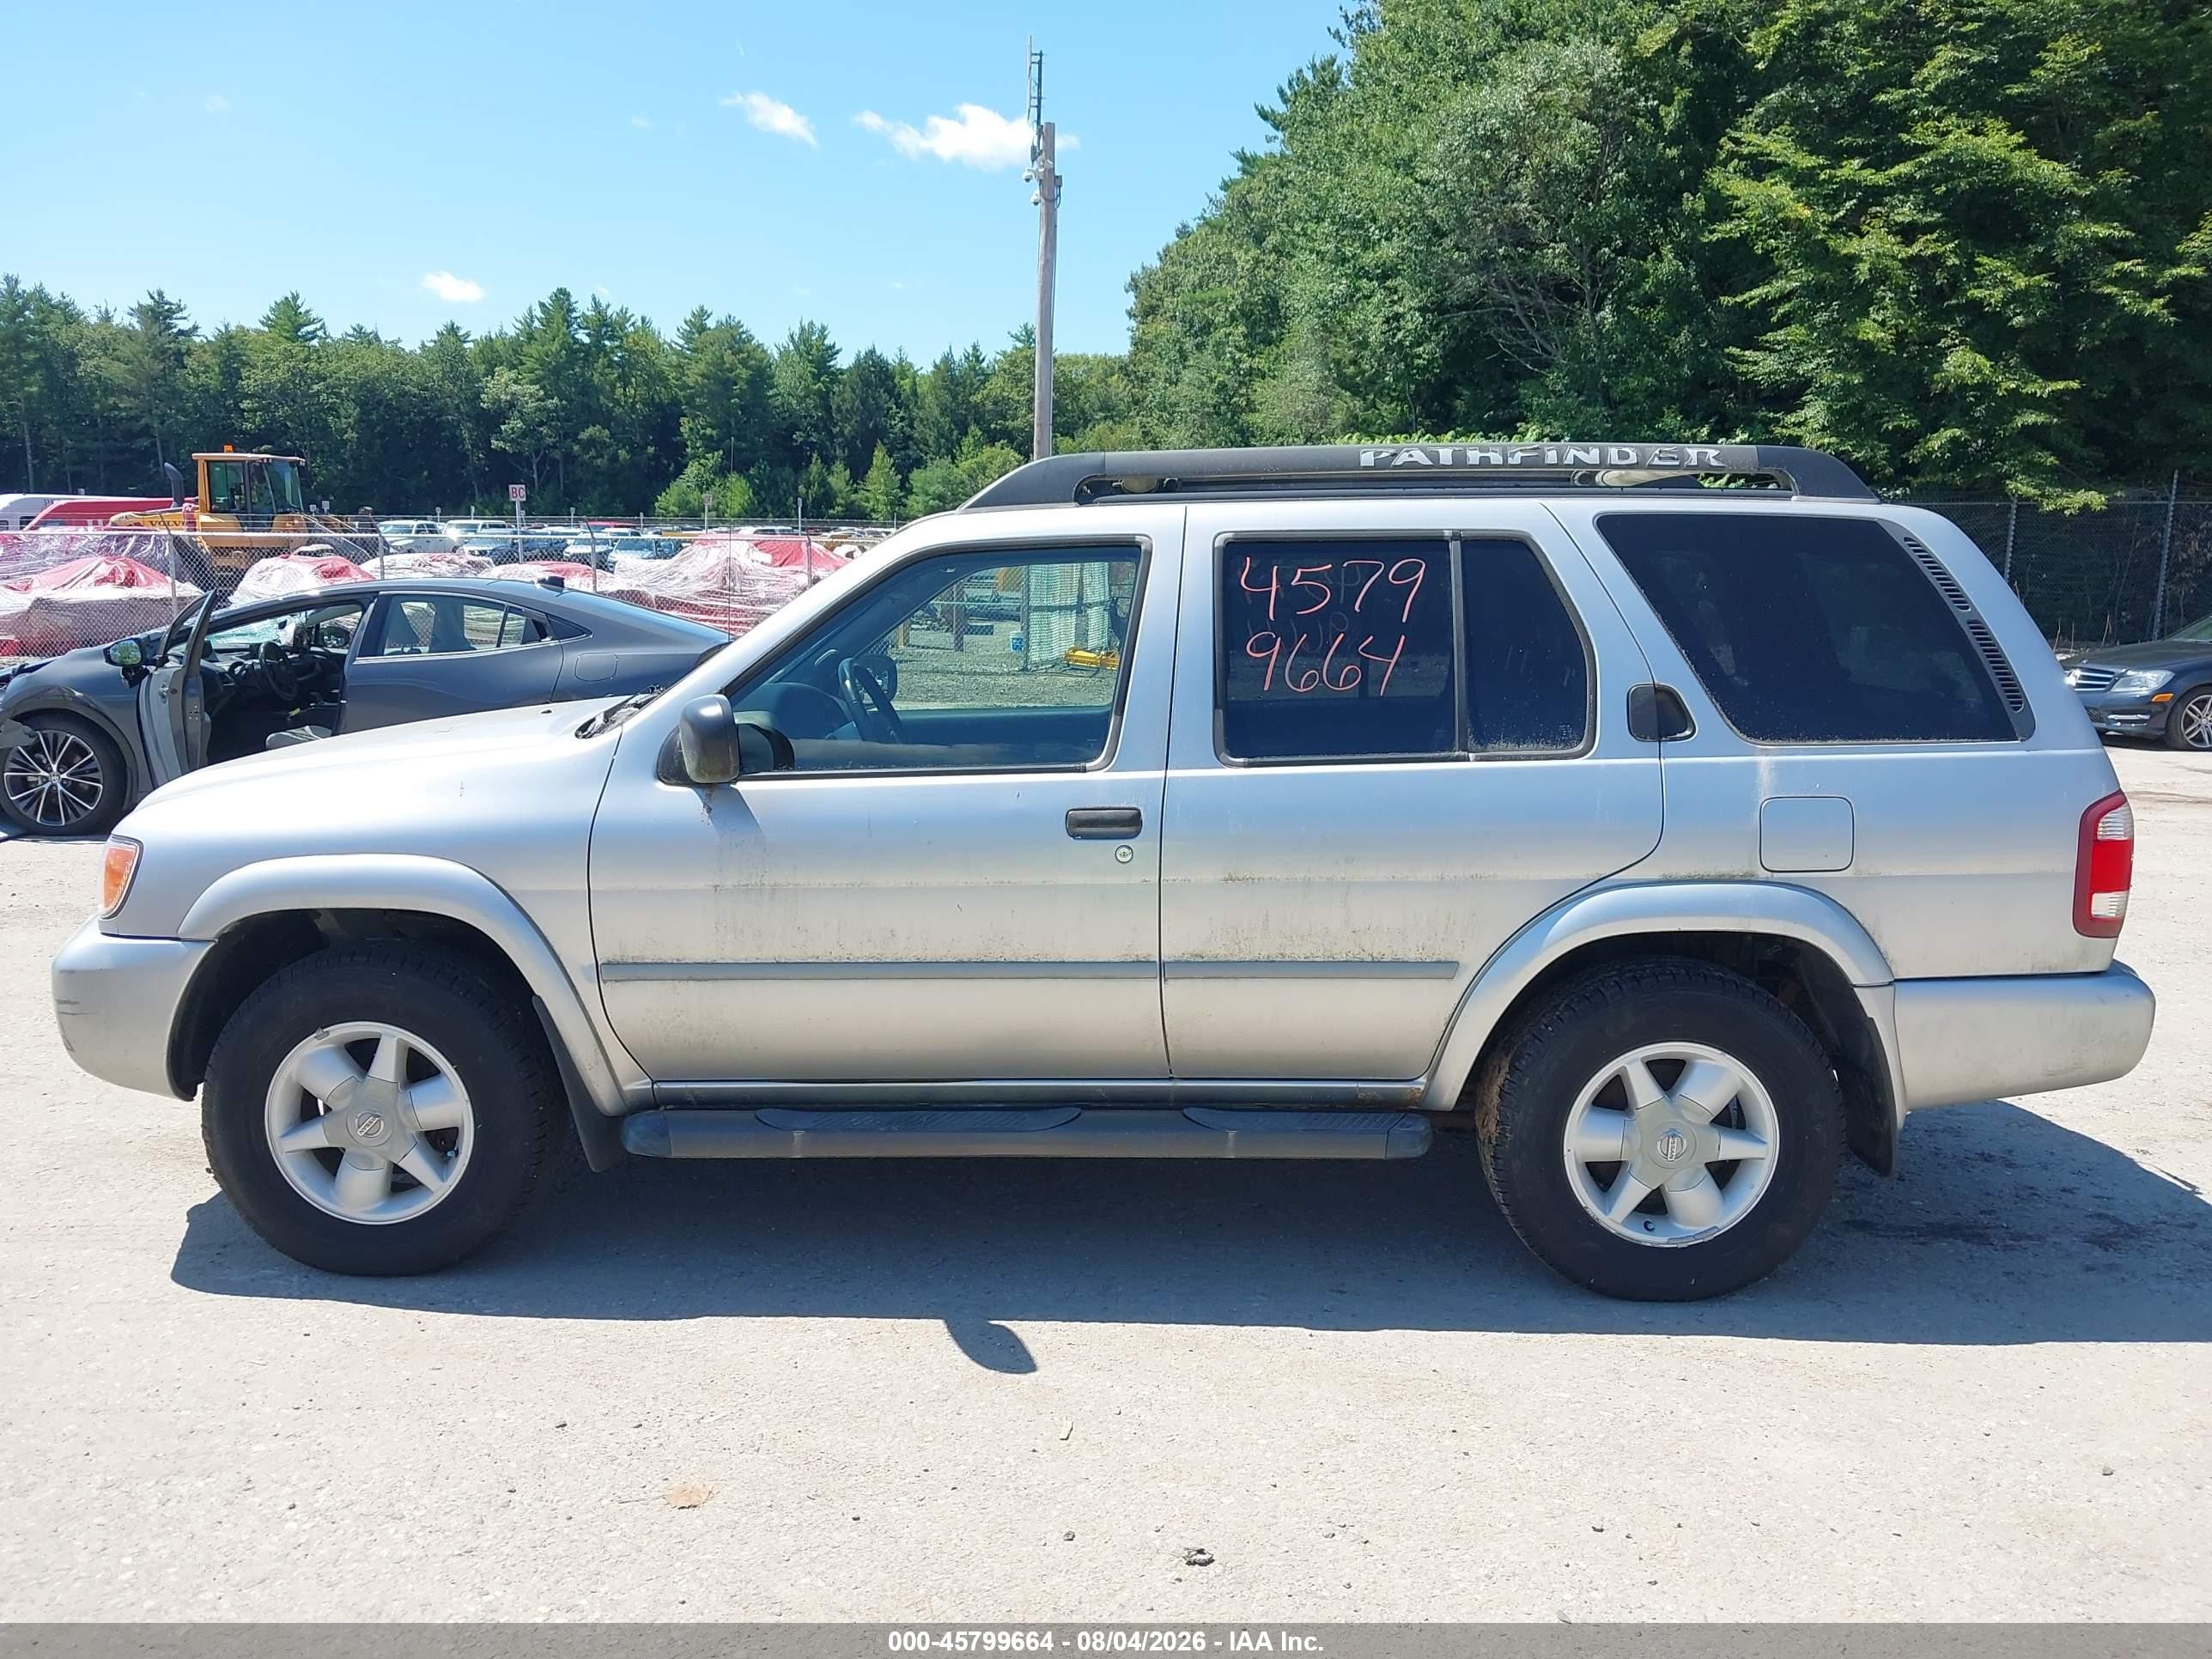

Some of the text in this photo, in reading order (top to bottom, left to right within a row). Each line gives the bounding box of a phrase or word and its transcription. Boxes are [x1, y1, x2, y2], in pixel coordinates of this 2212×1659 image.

[1359, 446, 1728, 467] PATHFINDER
[511, 486, 526, 499] BC
[1239, 556, 1427, 623] 4579
[1245, 630, 1407, 697] 9664
